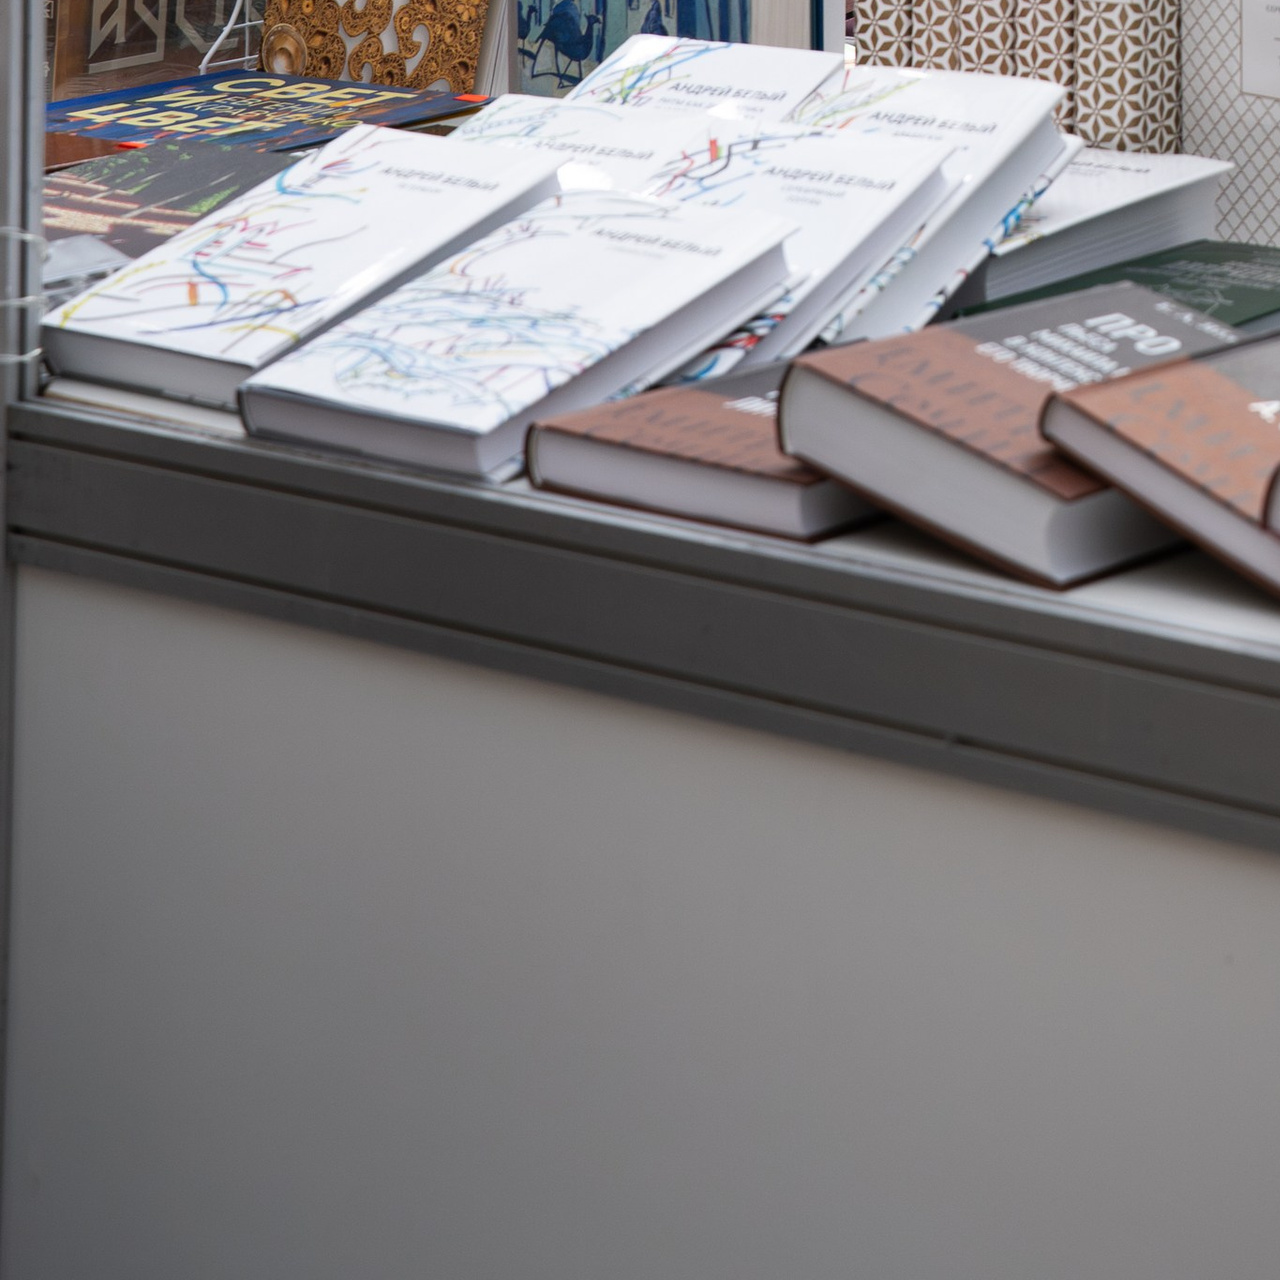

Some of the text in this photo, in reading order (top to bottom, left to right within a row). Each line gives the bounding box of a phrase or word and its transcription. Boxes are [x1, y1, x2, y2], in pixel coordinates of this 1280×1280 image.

[137, 89, 223, 109] И
[213, 78, 419, 108] СВЕТ
[669, 81, 733, 100] АНДРЕЙ
[66, 103, 288, 137] ЦВЕТ
[871, 110, 936, 128] АНДРЕЙ
[766, 165, 896, 192] АНДРЕЙ БЕЛЫЙ
[1085, 312, 1182, 356] ПРО
